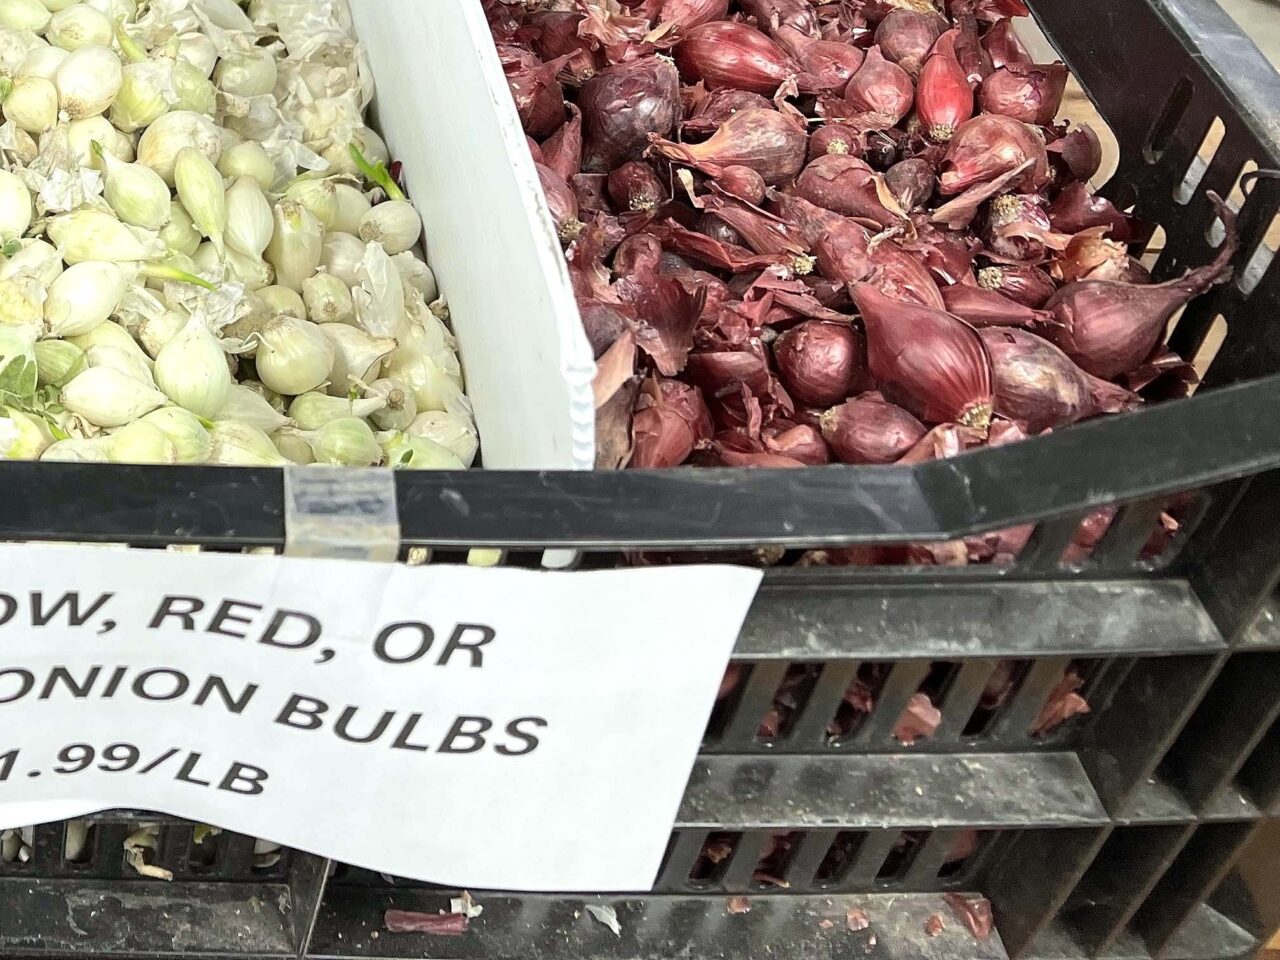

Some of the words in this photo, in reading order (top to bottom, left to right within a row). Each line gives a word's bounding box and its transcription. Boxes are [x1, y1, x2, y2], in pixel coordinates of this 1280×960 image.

[148, 596, 336, 664] RED,
[374, 622, 497, 668] OR
[274, 694, 549, 756] BULBS
